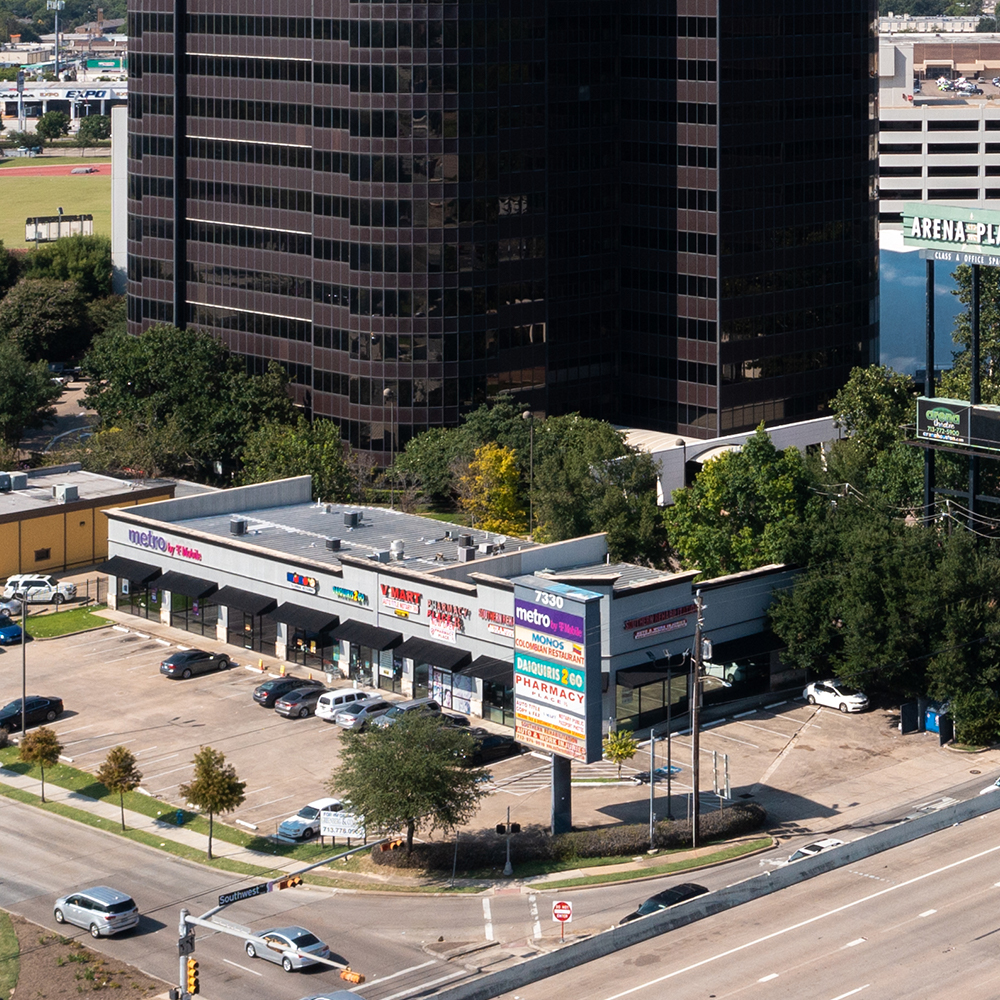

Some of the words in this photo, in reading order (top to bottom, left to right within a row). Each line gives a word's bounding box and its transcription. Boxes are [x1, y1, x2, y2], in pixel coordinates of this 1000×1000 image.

[66, 90, 107, 98] EXPO
[911, 216, 966, 243] ARENA
[934, 251, 952, 261] CLASS
[955, 253, 960, 261] A
[964, 254, 984, 264] OFFICE
[925, 409, 960, 425] arena
[128, 529, 167, 552] metro
[167, 542, 175, 557] by
[390, 586, 421, 604] MART
[534, 589, 564, 609] 7330
[516, 606, 551, 628] metro
[550, 619, 558, 633] by
[515, 638, 547, 654] COLOMBIAN
[548, 647, 585, 665] RESTAURANT
[532, 633, 565, 650] MONOS
[517, 657, 560, 682] DAIQUIRIS
[561, 668, 569, 685] 2
[569, 672, 583, 688] GO
[515, 675, 584, 704] PHARMACY
[516, 726, 532, 736] AUTO
[539, 733, 557, 745] WORK
[557, 740, 586, 754] INJURIES
[219, 886, 260, 905] Southwest
